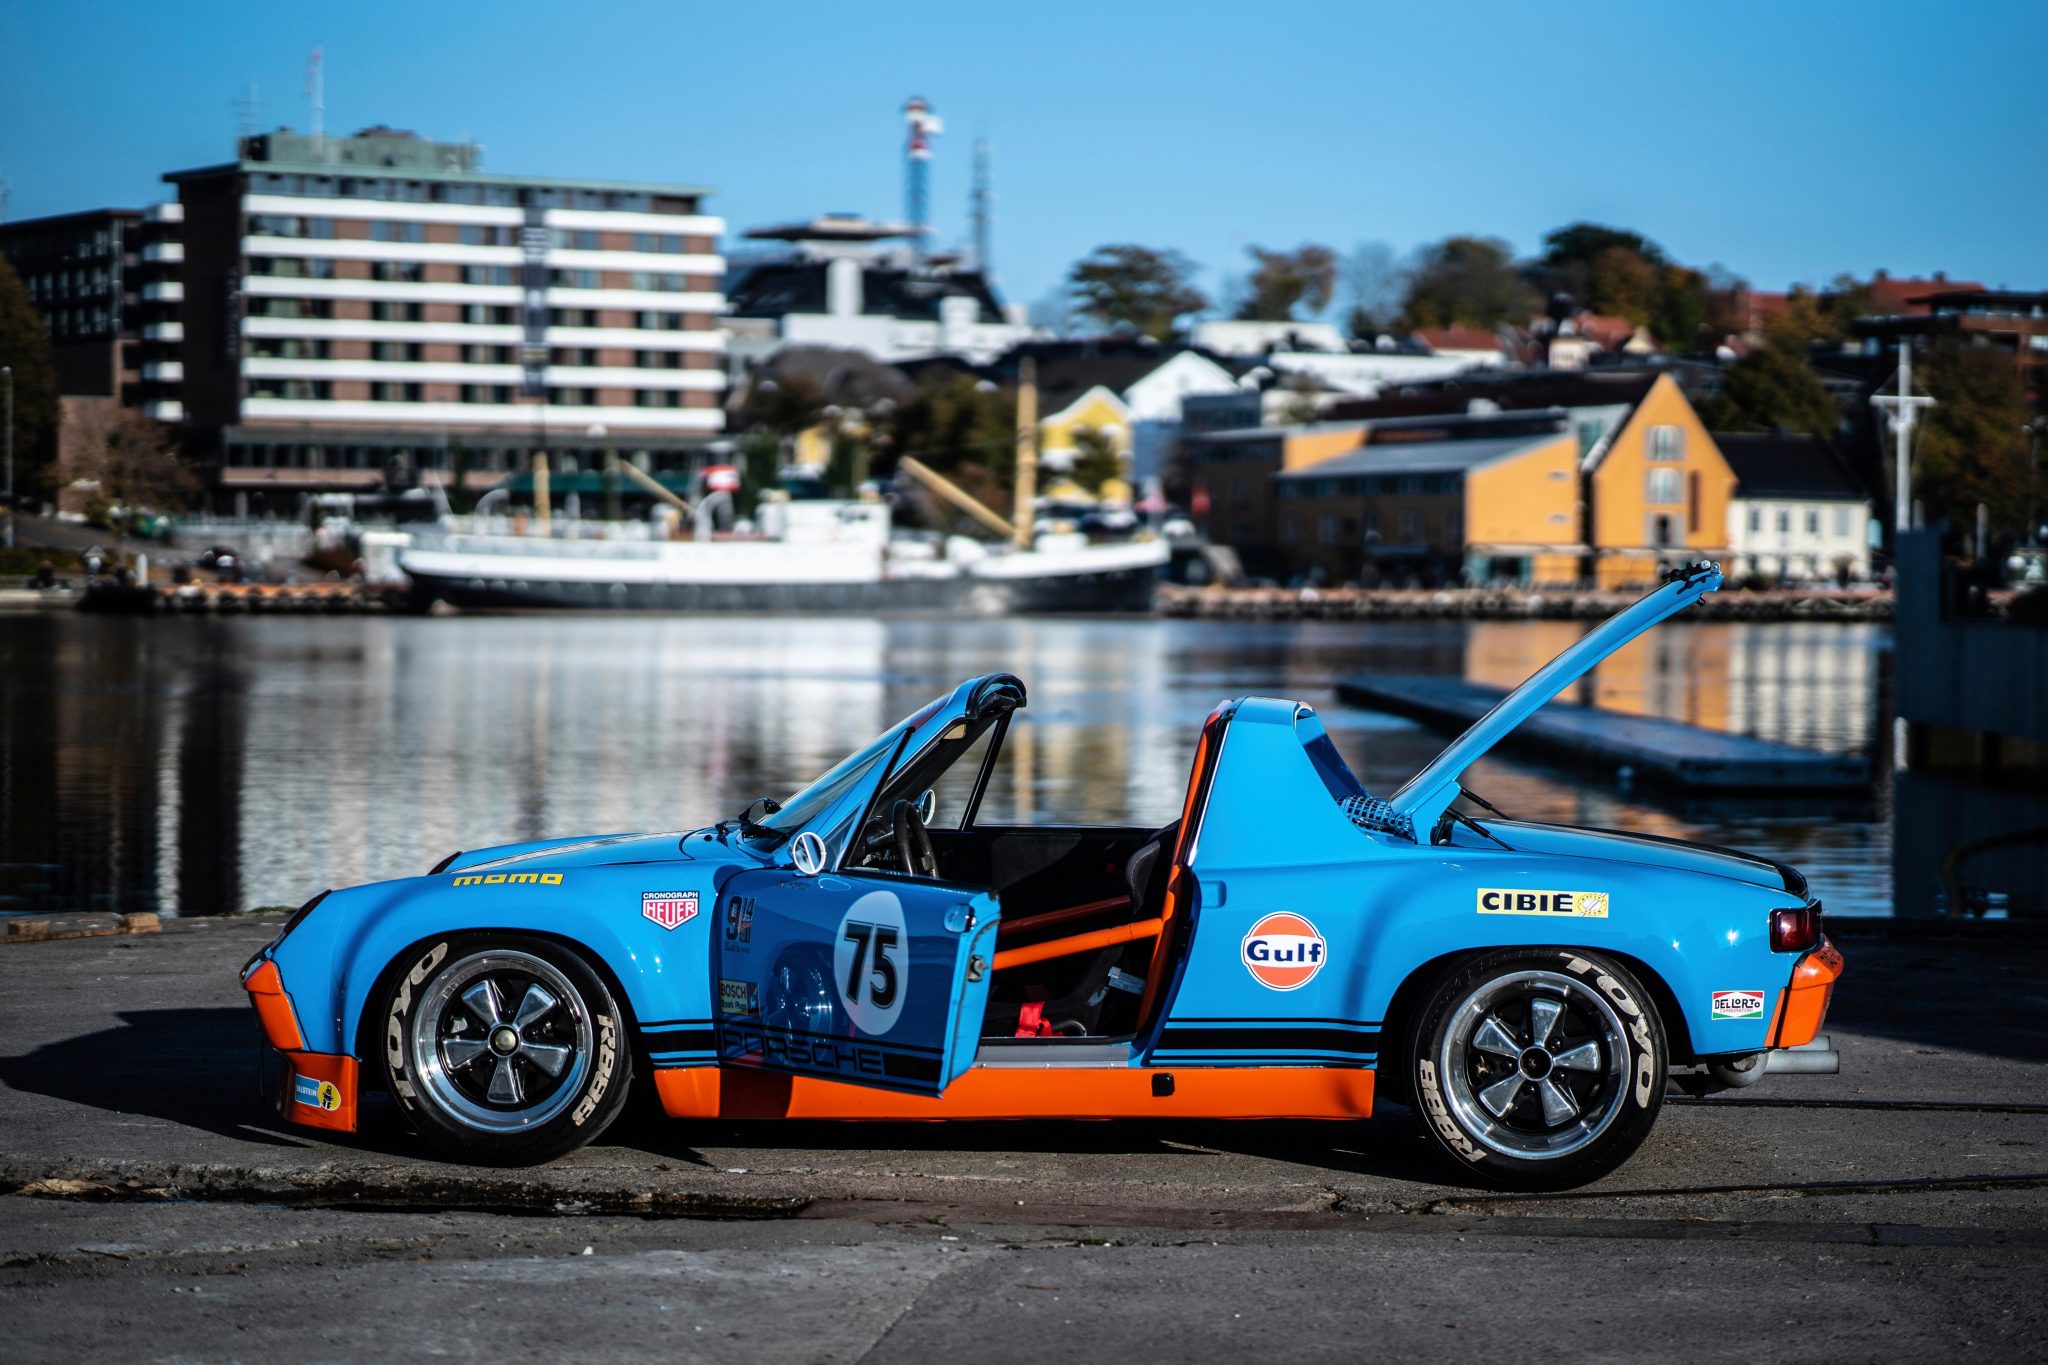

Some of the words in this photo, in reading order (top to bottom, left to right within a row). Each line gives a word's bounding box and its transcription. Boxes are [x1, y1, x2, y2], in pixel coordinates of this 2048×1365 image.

[452, 873, 564, 887] momo
[646, 901, 696, 925] HEUER
[844, 919, 900, 1009] 75
[1246, 940, 1322, 962] Gulf
[721, 983, 746, 999] BOSCH
[387, 942, 448, 1111] TOYO
[721, 1029, 883, 1075] PORSCHE
[1559, 952, 1654, 1109] TOYO
[572, 1014, 616, 1127] R888
[1420, 1059, 1487, 1162] R888
